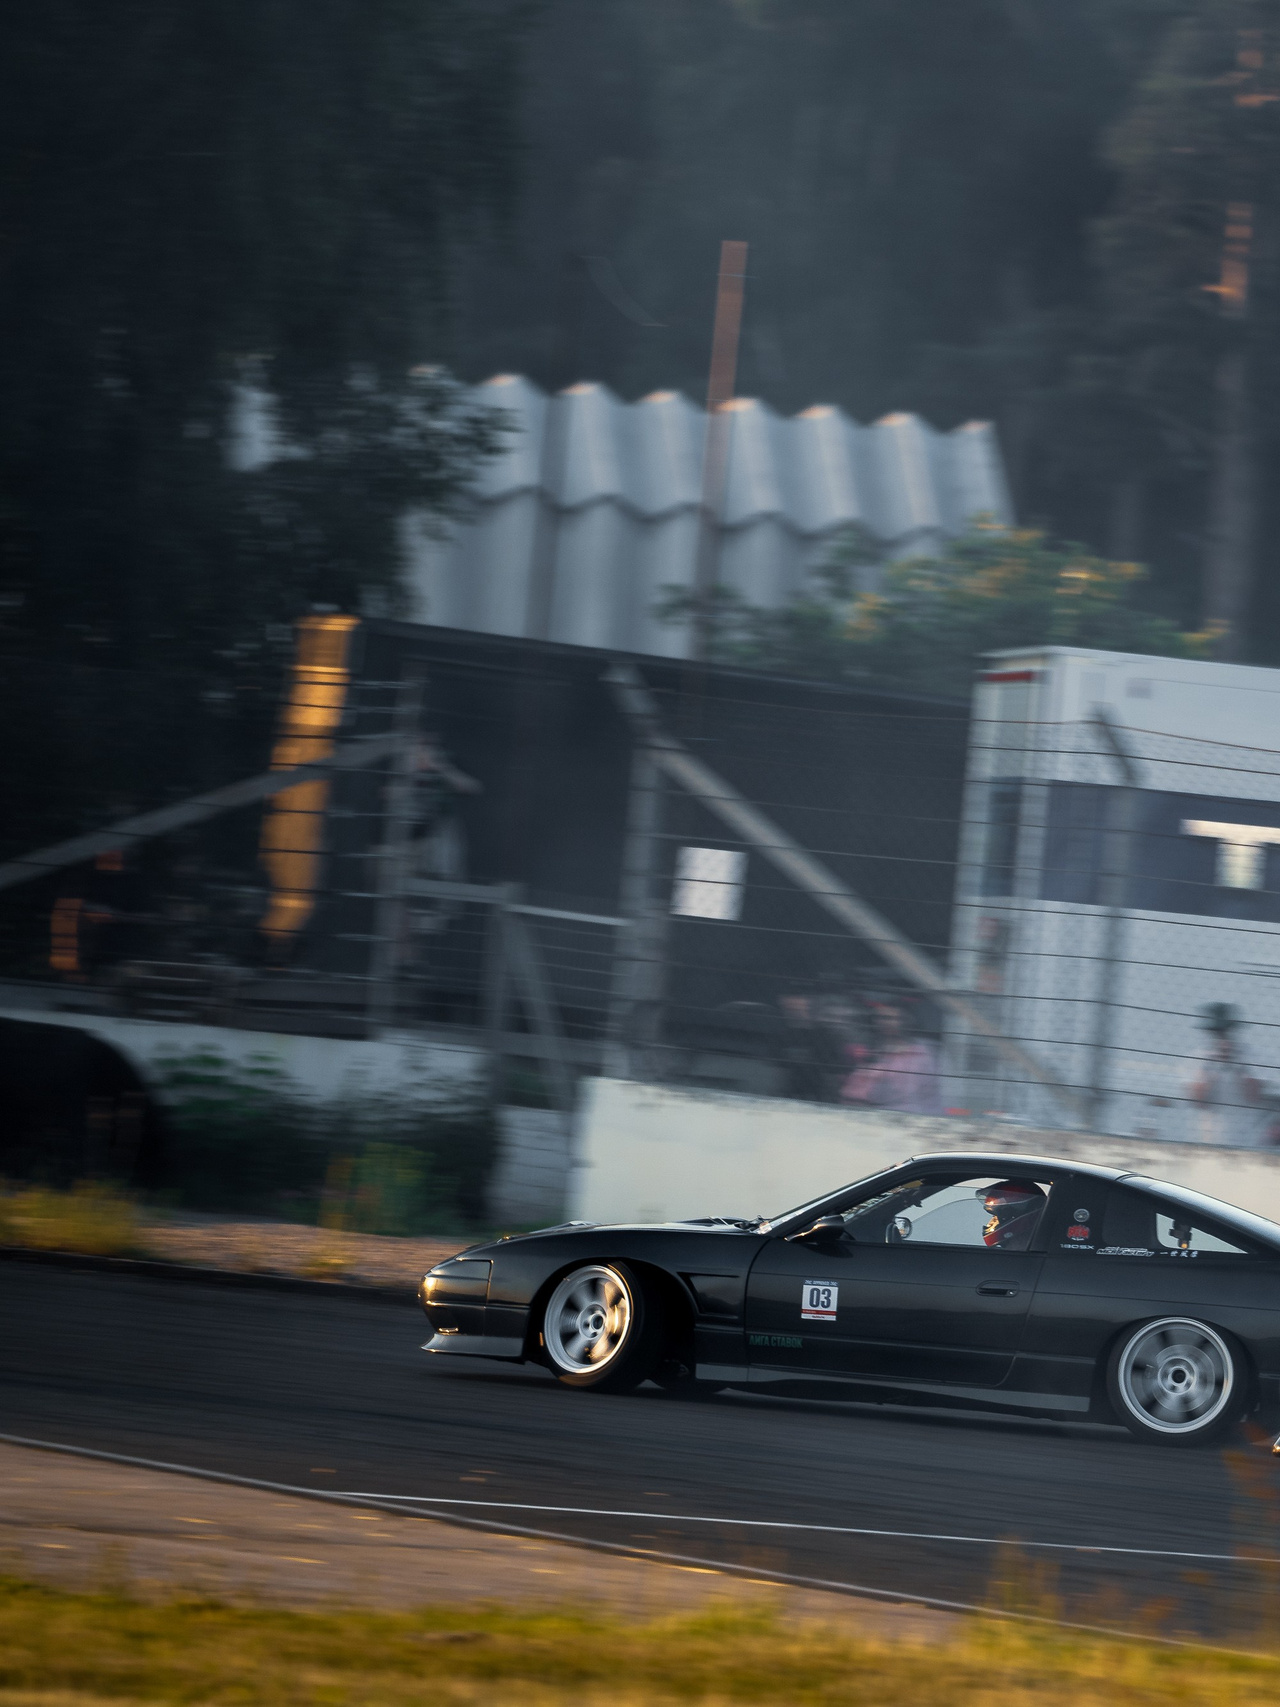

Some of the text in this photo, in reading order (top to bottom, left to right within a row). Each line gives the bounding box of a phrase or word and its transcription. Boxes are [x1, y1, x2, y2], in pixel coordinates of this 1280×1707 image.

[809, 1288, 831, 1308] 03
[749, 1335, 803, 1348] ЛИГА СТАВОК
